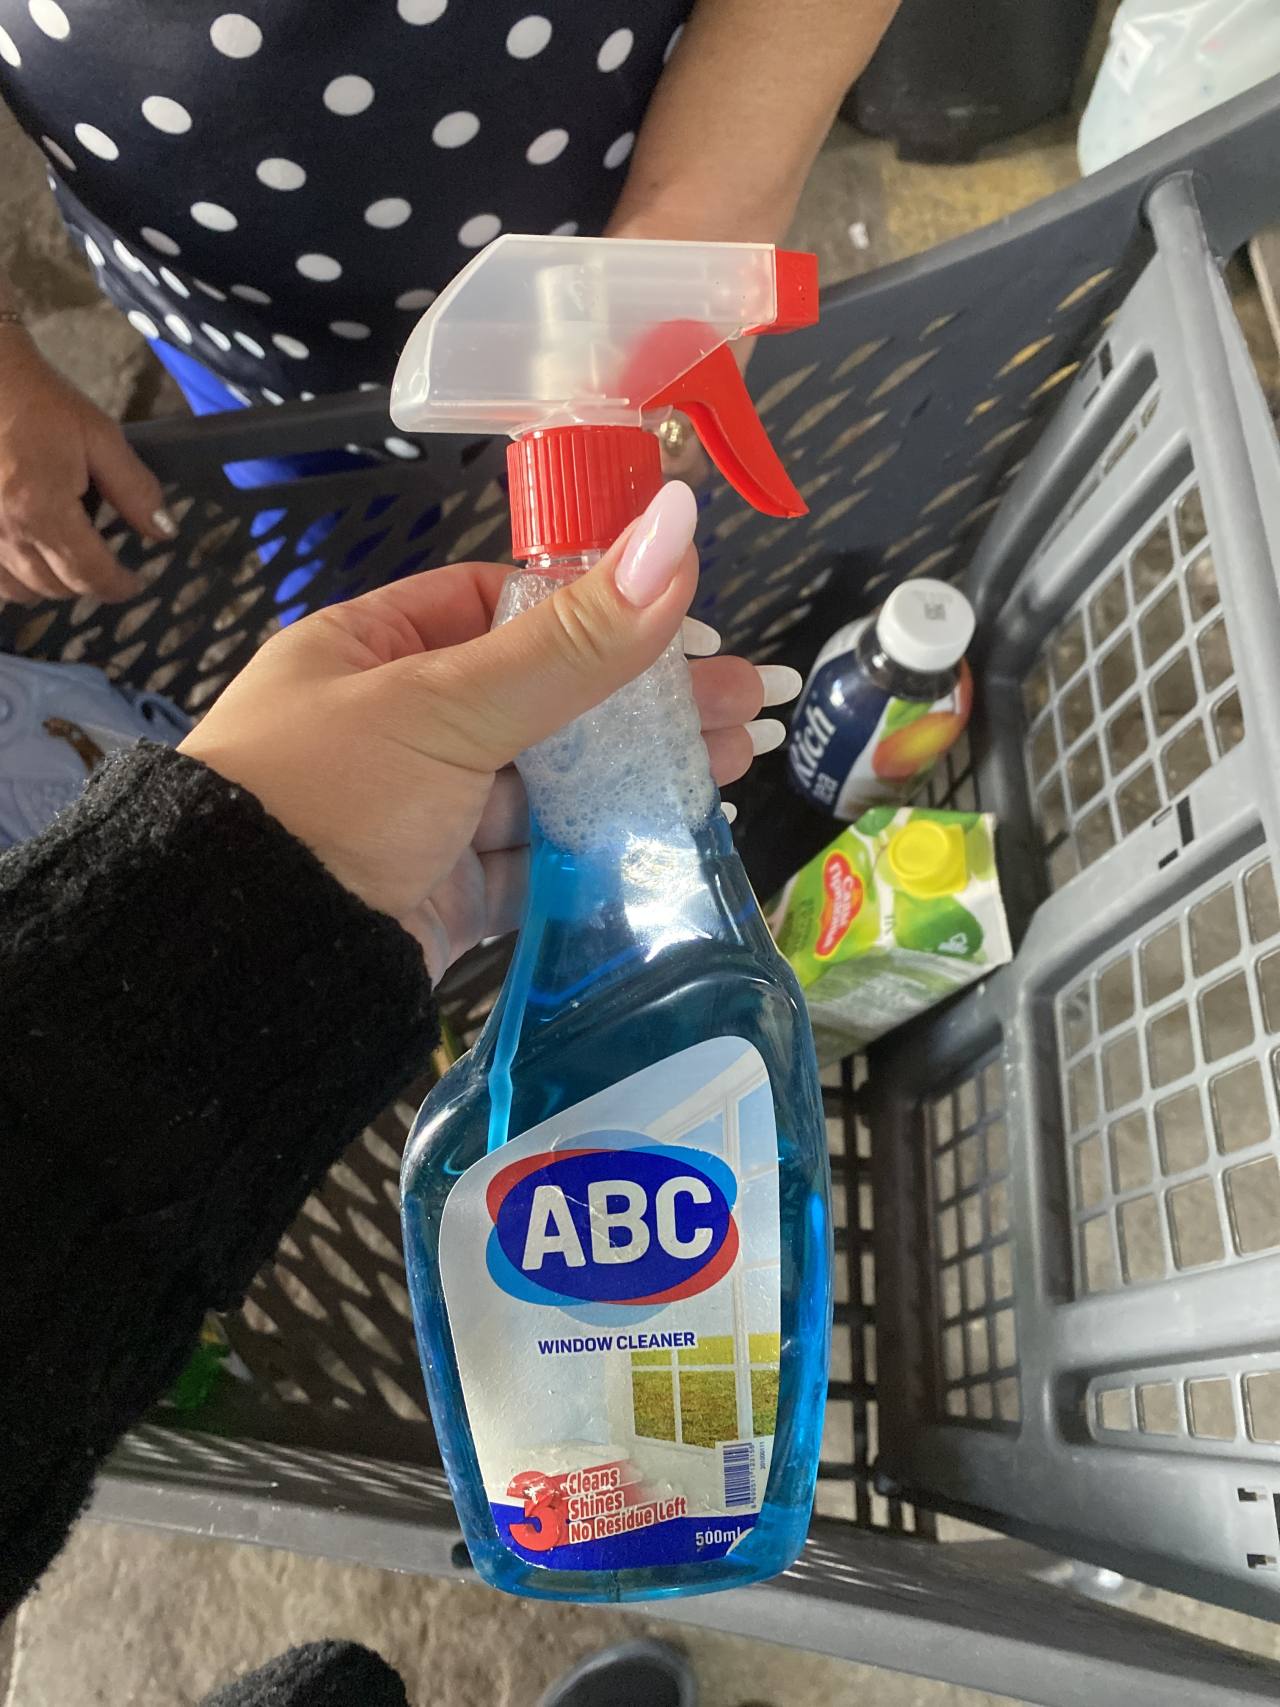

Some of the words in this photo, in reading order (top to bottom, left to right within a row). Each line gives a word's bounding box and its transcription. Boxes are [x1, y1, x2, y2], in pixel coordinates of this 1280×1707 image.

[522, 1176, 713, 1270] ABC
[538, 1336, 613, 1354] WINDOW
[617, 1332, 695, 1349] CLEANER
[567, 1467, 620, 1495] Cleans
[506, 1471, 559, 1551] 3
[568, 1492, 623, 1520] Shines
[569, 1522, 591, 1543] No
[595, 1508, 654, 1538] Residue
[657, 1496, 687, 1520] Left
[695, 1526, 741, 1546] 500ml
